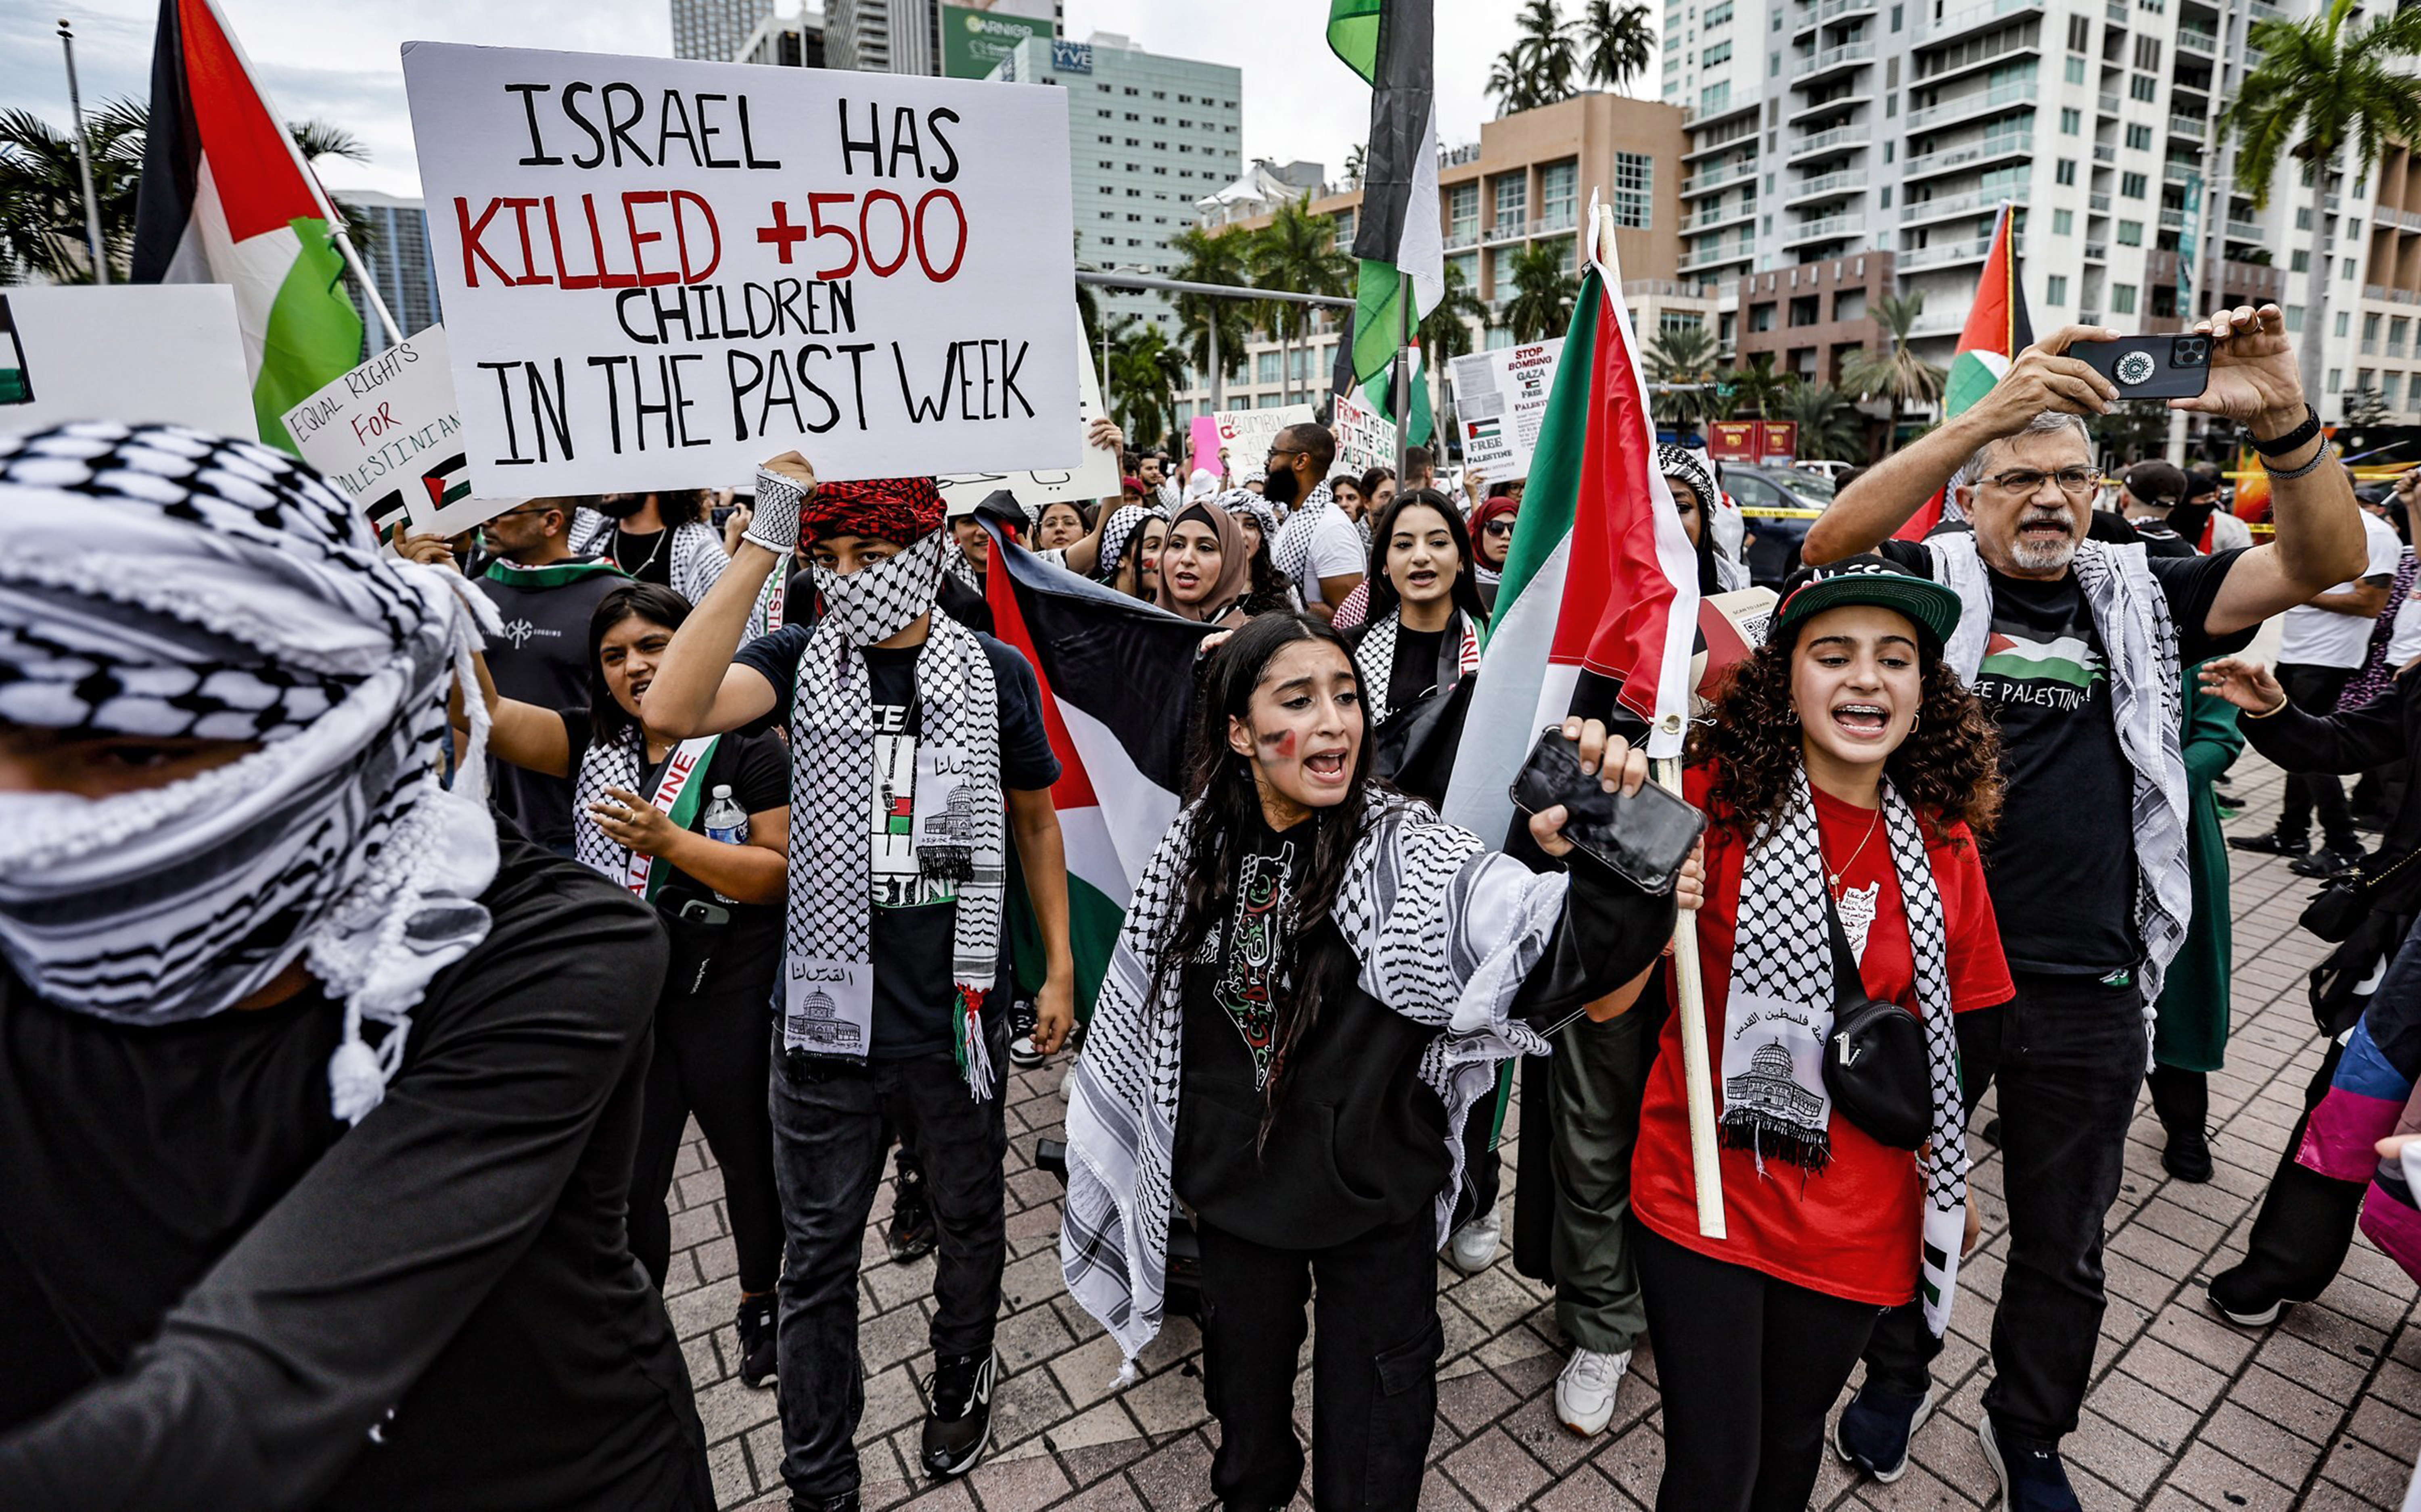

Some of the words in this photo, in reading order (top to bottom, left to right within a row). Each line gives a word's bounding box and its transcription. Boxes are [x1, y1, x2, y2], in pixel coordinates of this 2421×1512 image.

[1053, 46, 1092, 65] YVE
[504, 81, 782, 169] ISRAEL
[838, 98, 960, 183] HAS
[453, 190, 721, 290] KILLED
[757, 188, 968, 283] +500
[615, 278, 856, 344] CHILDREN
[1516, 347, 1543, 359] STOP
[1508, 355, 1552, 371] BOMBING
[1517, 368, 1545, 381] GAZA
[290, 397, 344, 443] EQUAL
[345, 342, 419, 399] RIGHTS
[1521, 388, 1543, 399] FREE
[477, 357, 574, 465] IN
[587, 355, 711, 454] THE
[727, 343, 875, 441] PAST
[891, 339, 1035, 423] WEEK
[1514, 399, 1548, 411] PALEST
[351, 401, 402, 446] FOR
[1337, 397, 1361, 426] FROM
[1361, 411, 1380, 435] THE
[1341, 423, 1352, 442] TO
[1355, 428, 1374, 449] THE
[1470, 436, 1503, 452] FREE
[1242, 453, 1260, 466] IS
[1467, 449, 1513, 464] PALESTINE
[1970, 680, 1995, 698] EE
[1733, 1011, 1760, 1040] القدس
[1765, 1008, 1808, 1026] فلسطين
